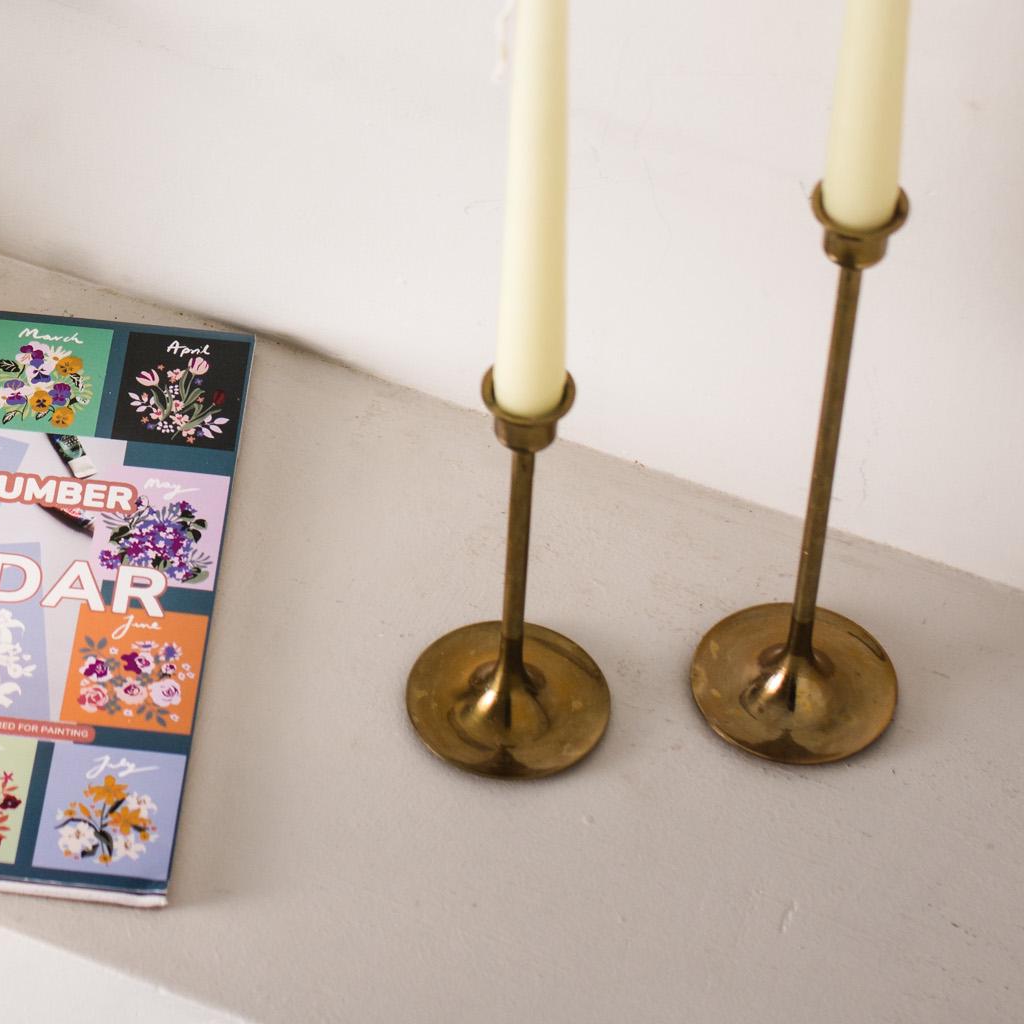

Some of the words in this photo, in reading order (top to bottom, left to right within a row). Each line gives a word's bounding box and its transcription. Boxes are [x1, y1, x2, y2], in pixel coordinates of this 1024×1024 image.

[18, 327, 83, 345] March
[167, 339, 210, 356] April
[144, 477, 200, 500] May
[111, 613, 162, 641] June
[18, 722, 38, 732] FOR
[40, 724, 89, 738] PAINTING
[85, 755, 160, 779] July
